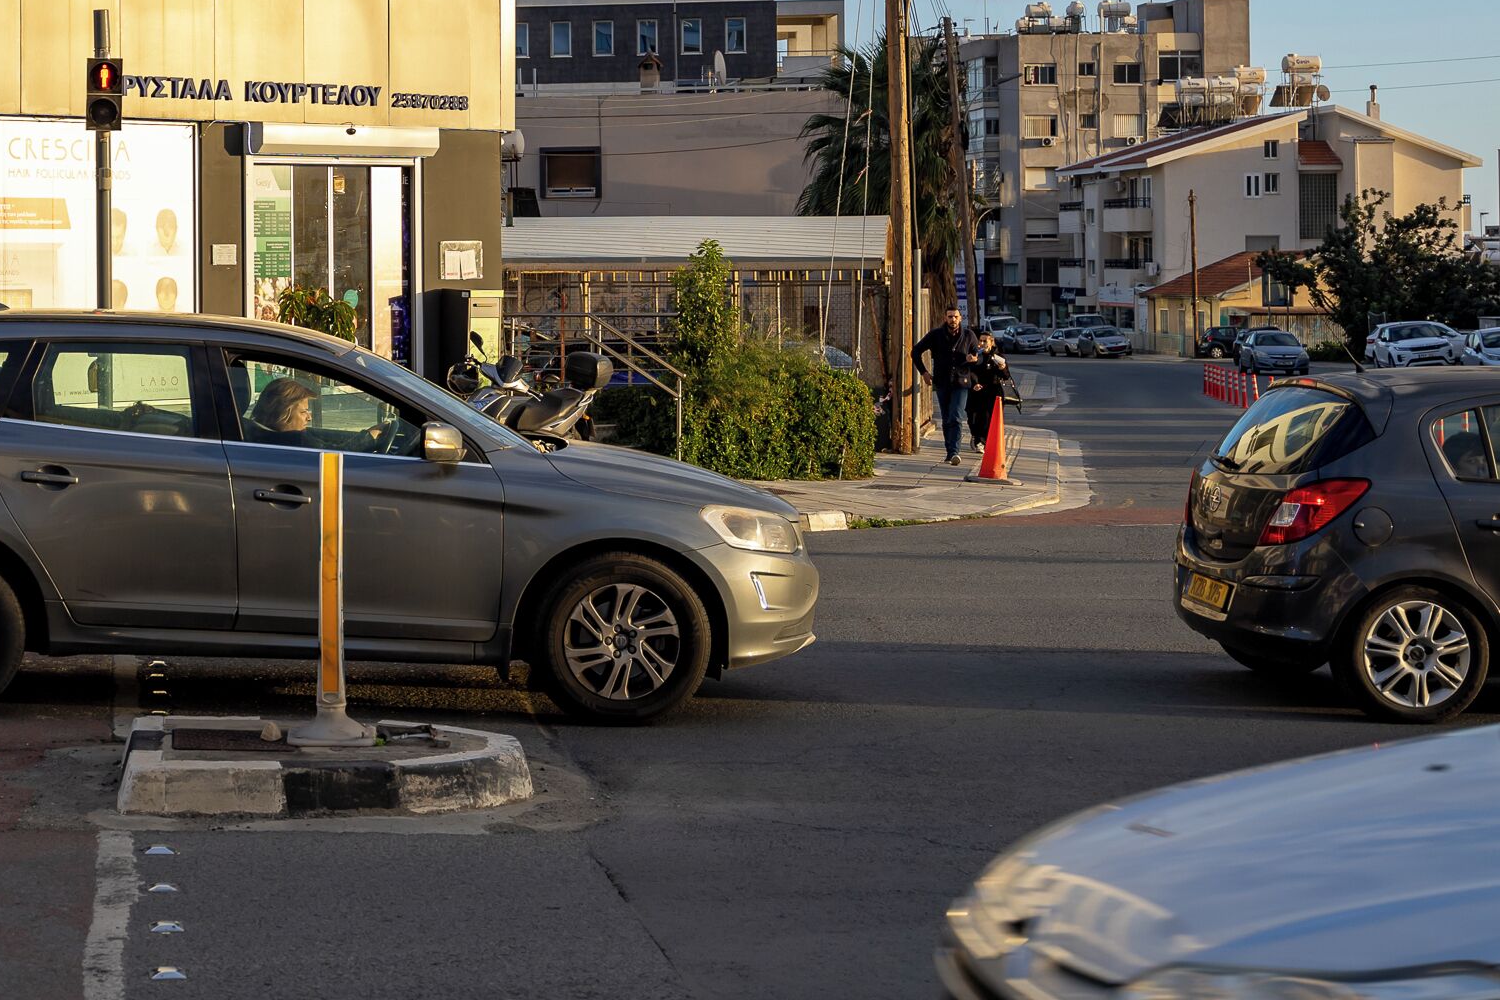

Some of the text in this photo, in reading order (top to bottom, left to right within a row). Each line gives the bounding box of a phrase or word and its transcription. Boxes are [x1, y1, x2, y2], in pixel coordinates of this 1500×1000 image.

[121, 75, 233, 101] ΡΥΣΤΑΛΑ
[8, 137, 131, 162] CRESCIA
[8, 168, 31, 179] HAIR
[36, 168, 89, 180] FOLLICULAR
[140, 376, 180, 387] LABO
